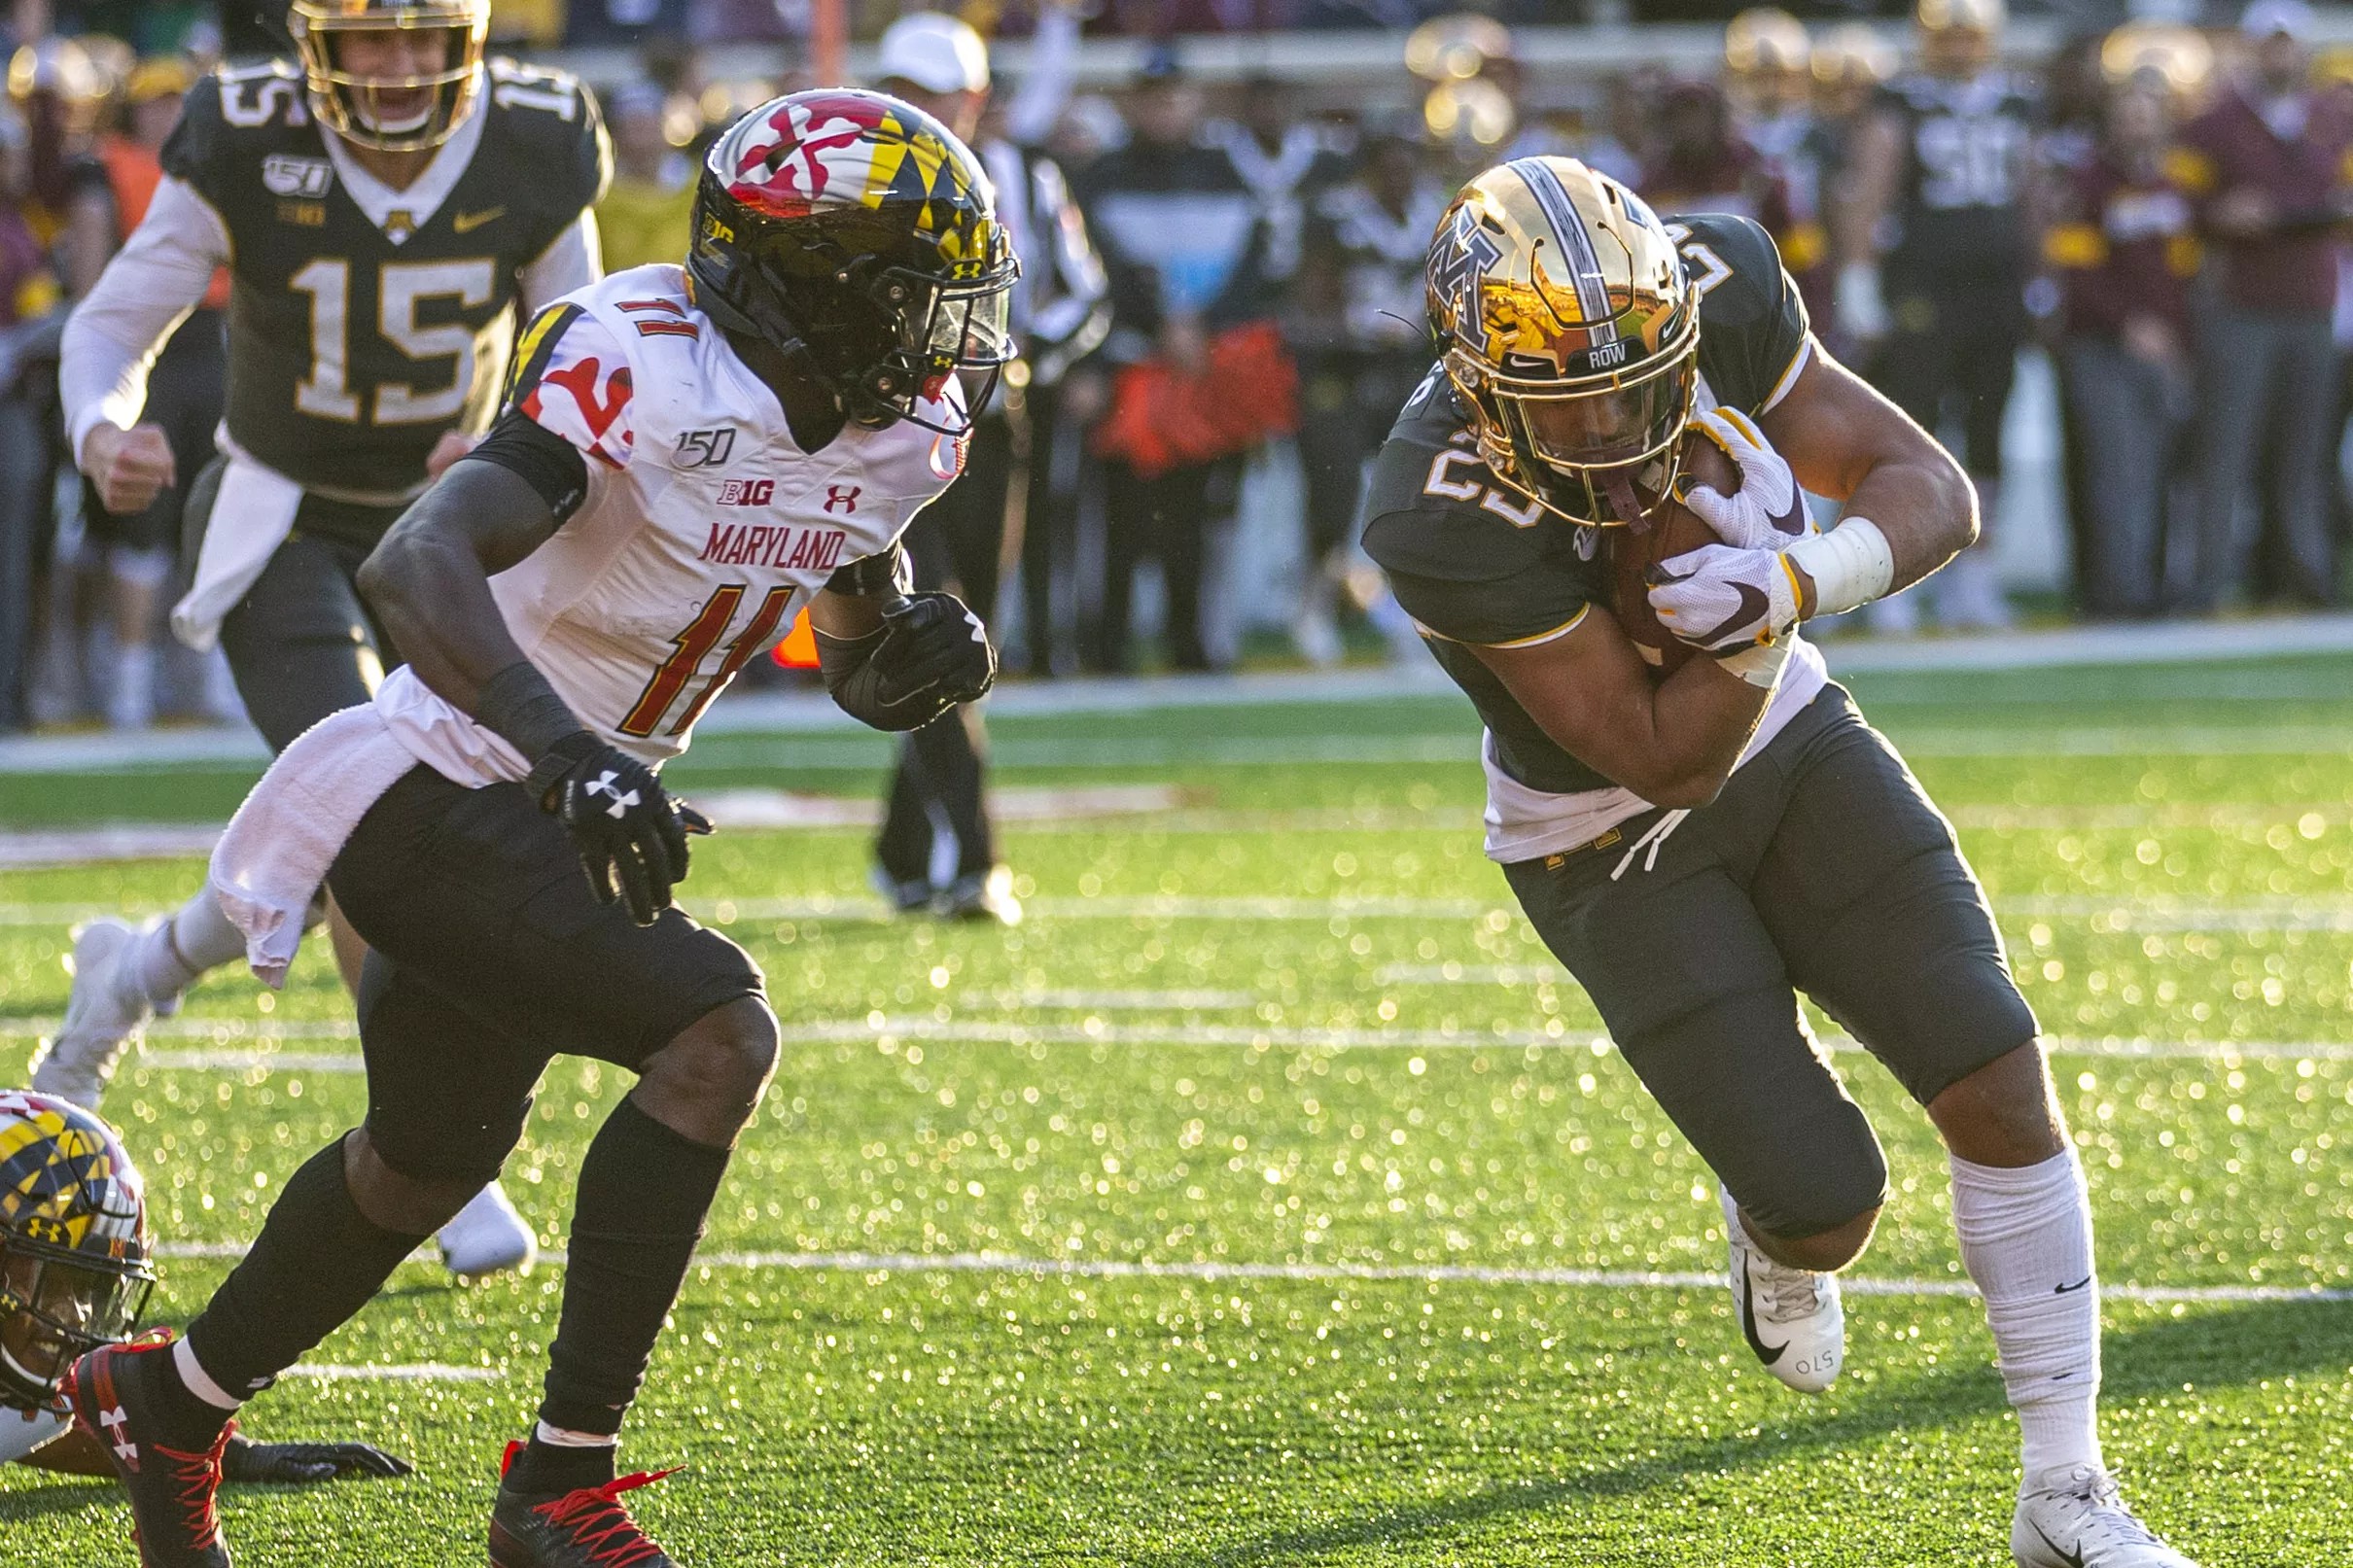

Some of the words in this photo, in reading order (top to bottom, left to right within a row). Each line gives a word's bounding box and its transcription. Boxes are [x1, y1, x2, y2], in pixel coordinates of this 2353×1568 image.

[288, 255, 497, 428] 15
[614, 297, 700, 342] 11
[1589, 343, 1626, 368] ROW
[672, 428, 737, 468] 150
[697, 522, 847, 572] MARYLAND
[615, 583, 798, 739] 11
